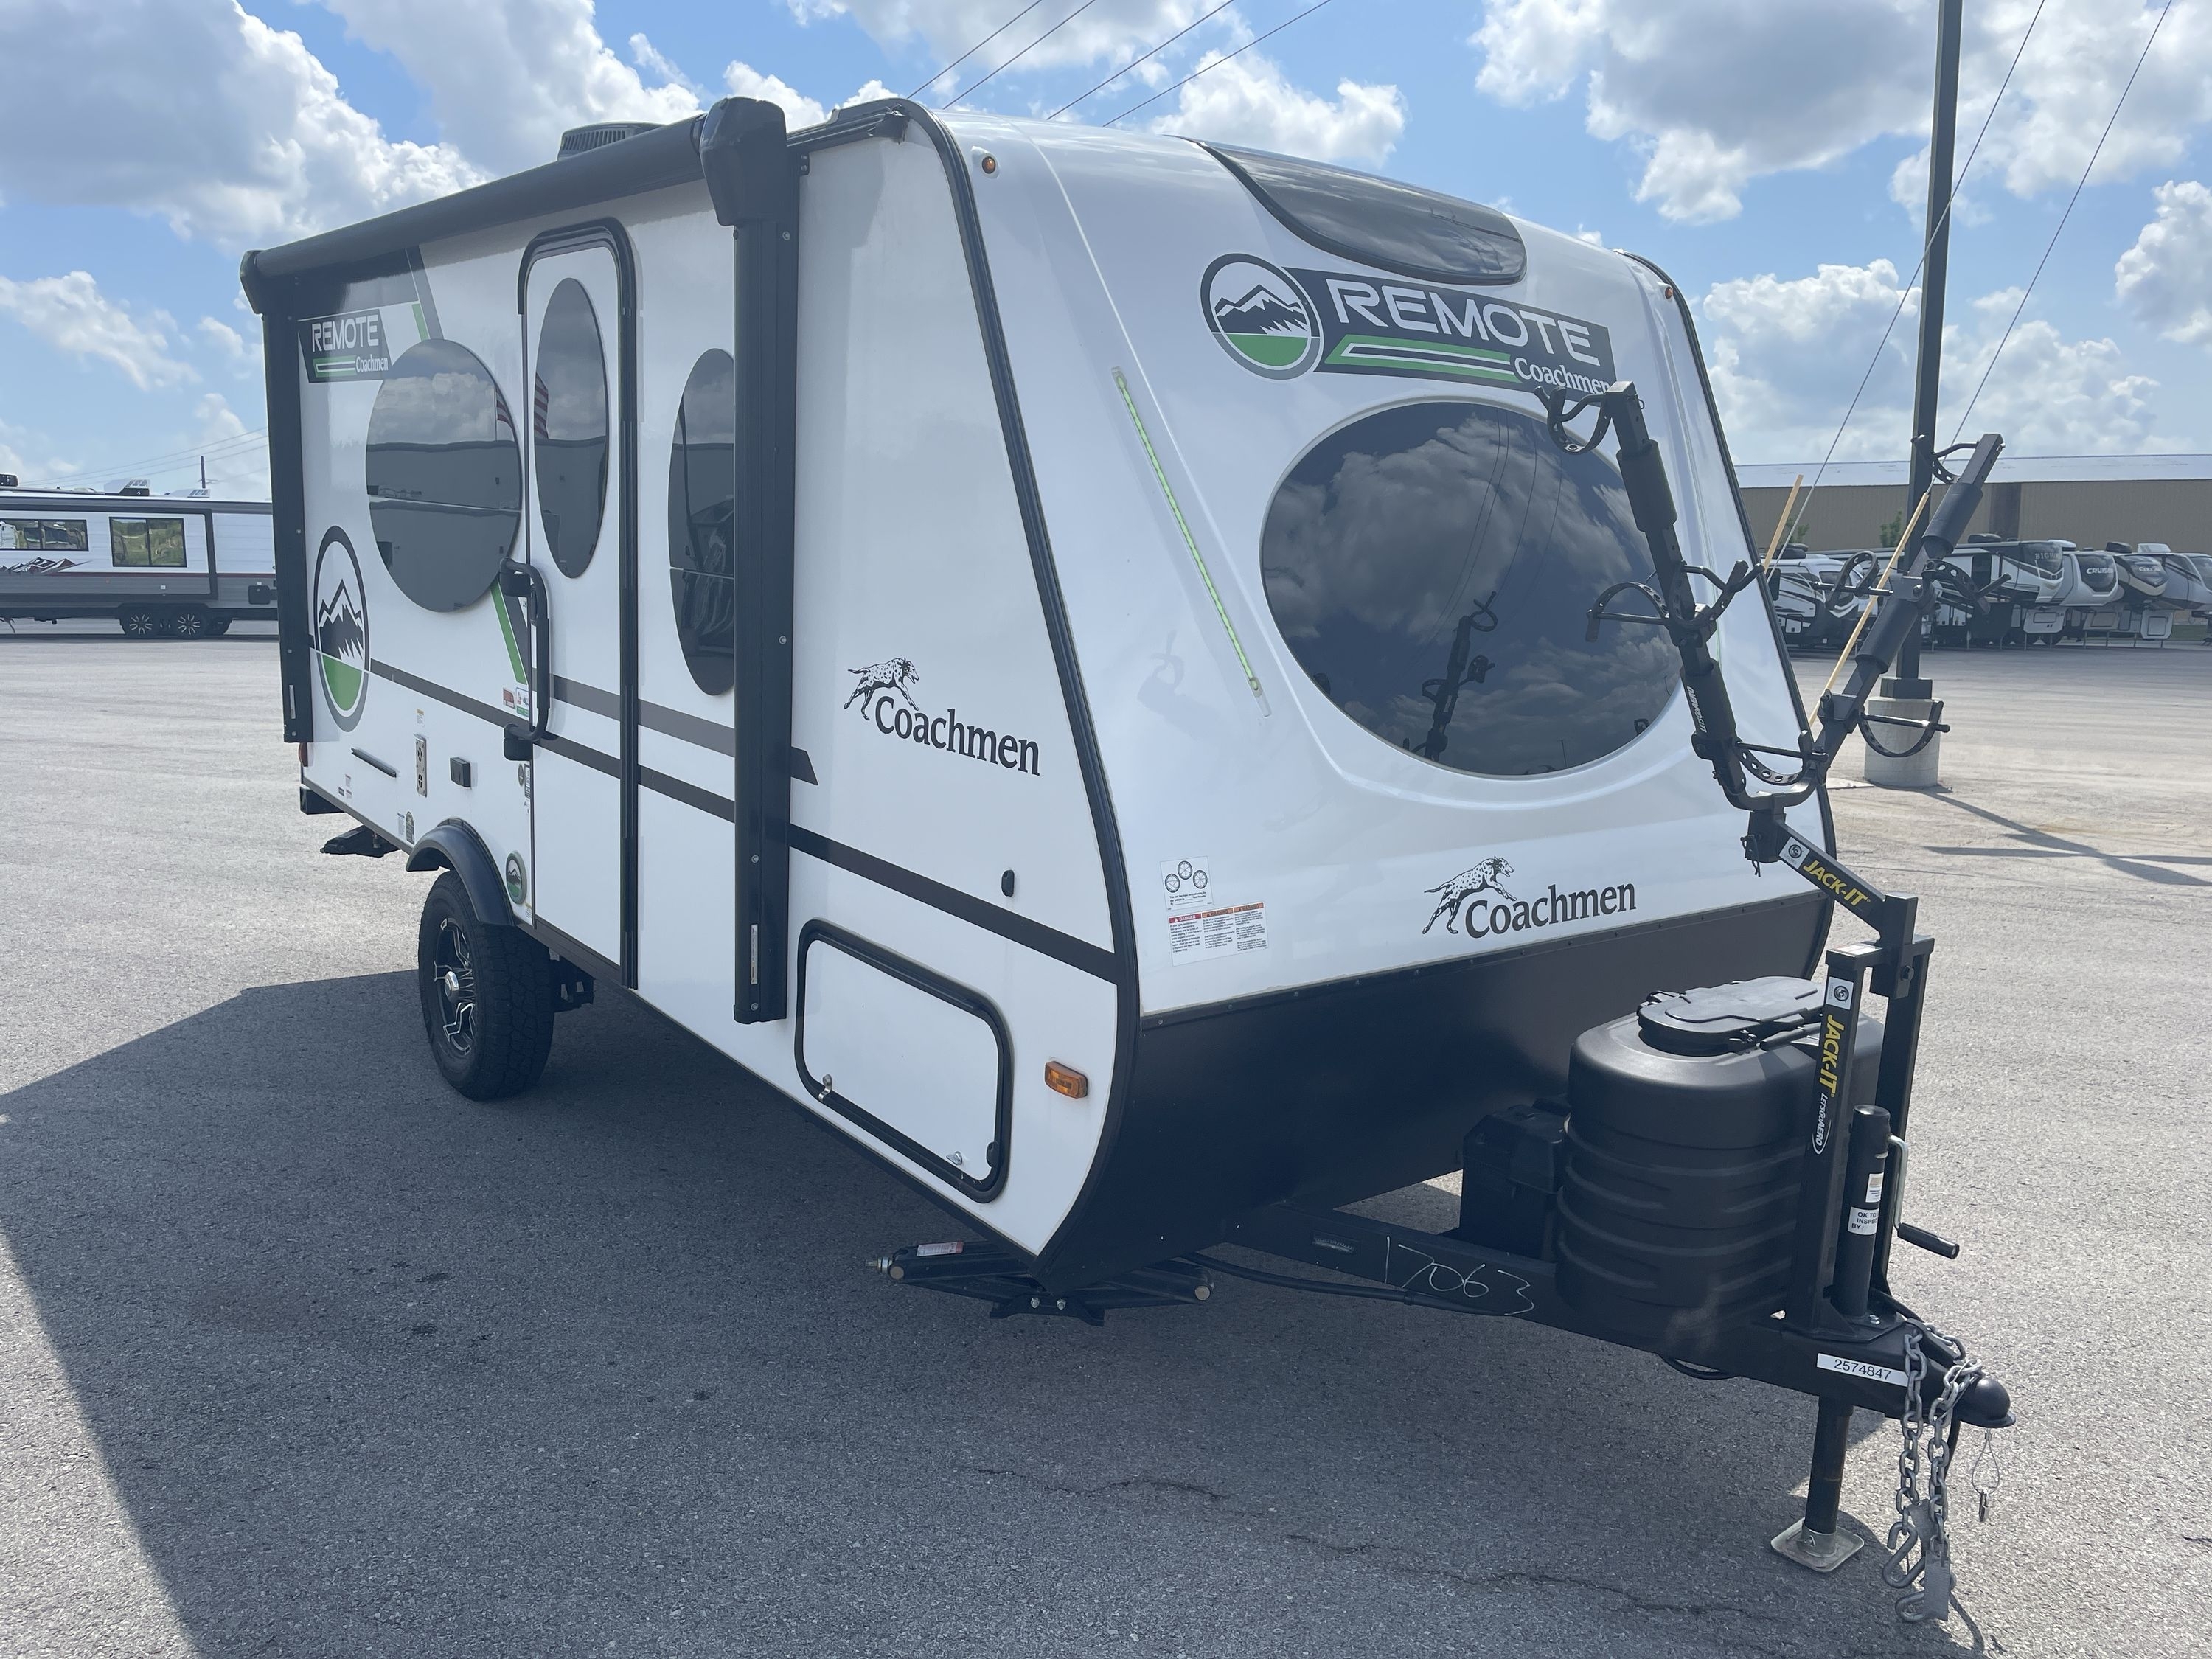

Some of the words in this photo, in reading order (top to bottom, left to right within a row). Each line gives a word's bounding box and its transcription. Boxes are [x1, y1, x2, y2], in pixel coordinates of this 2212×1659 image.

[312, 315, 379, 352] REMOTE
[1326, 279, 1601, 366] REMOTE
[355, 354, 389, 372] Coachmen
[1514, 357, 1610, 394] Coachmen
[875, 695, 1040, 776] Coachmen
[1803, 860, 1869, 907] JACK-IT
[1464, 883, 1636, 939] Coachmen
[1819, 1014, 1845, 1096] JACK-IT
[1385, 1235, 1535, 1316] 17063
[1834, 1359, 1892, 1380] 2574847
